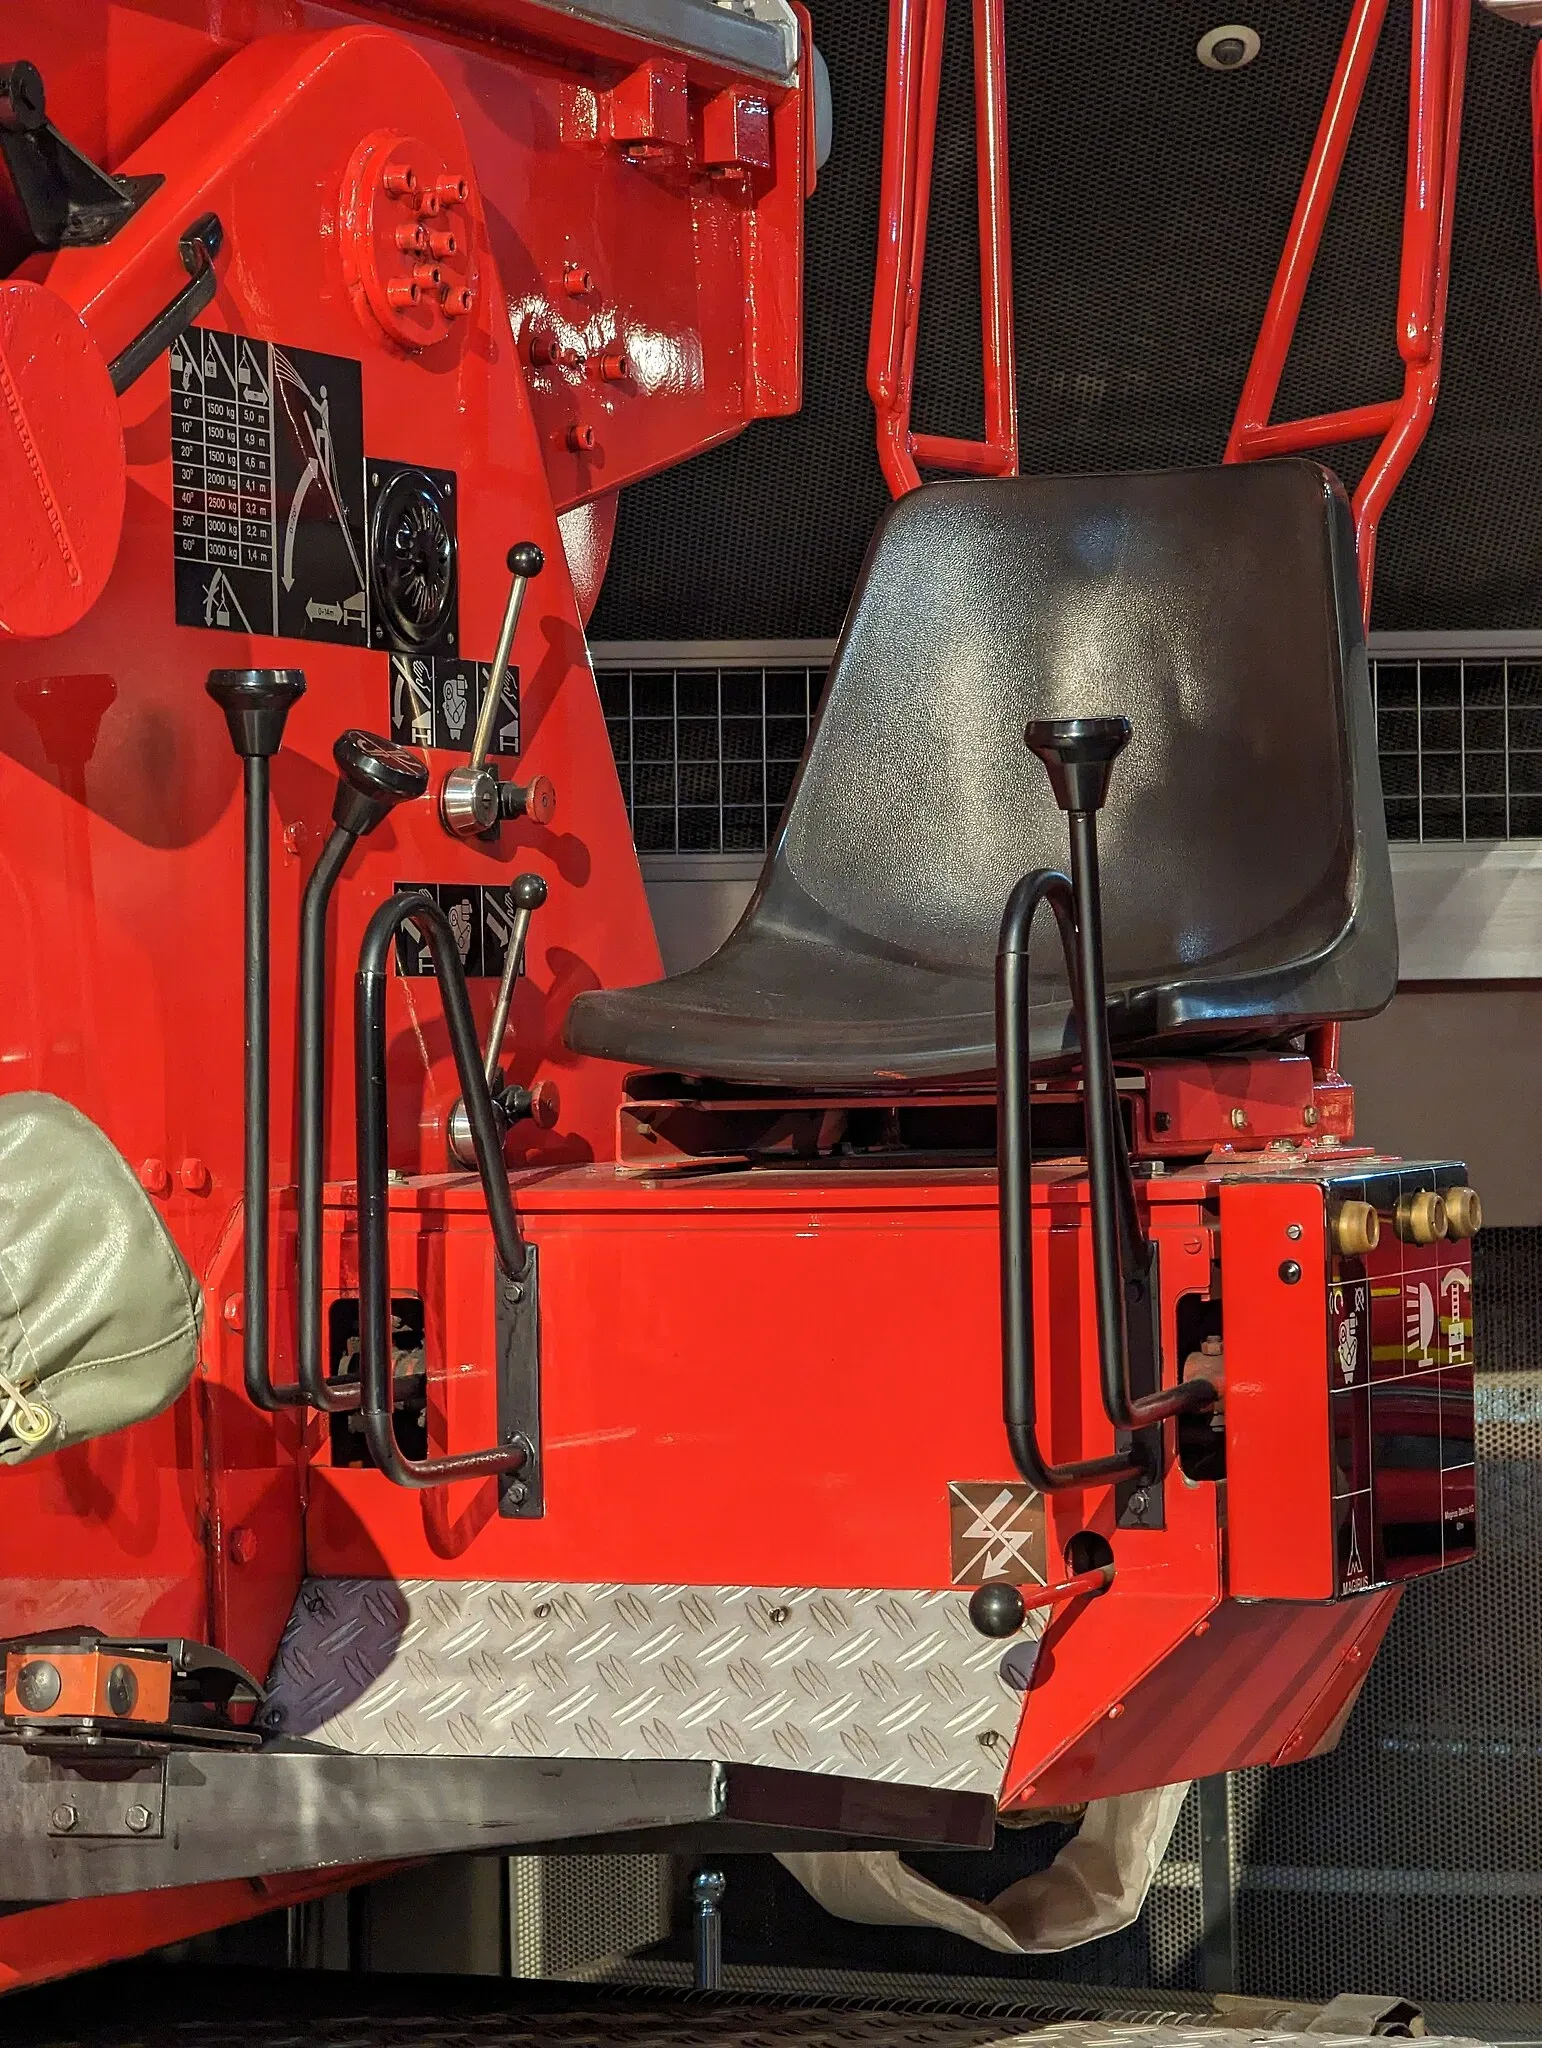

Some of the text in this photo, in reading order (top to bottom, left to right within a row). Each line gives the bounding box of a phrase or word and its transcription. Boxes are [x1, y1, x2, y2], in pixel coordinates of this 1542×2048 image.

[207, 402, 224, 415] 1500
[226, 406, 235, 420] kg
[244, 410, 254, 422] 5,0
[258, 415, 264, 424] m
[208, 426, 224, 439] 1500
[226, 429, 235, 443] kg
[244, 433, 255, 446] 4,9
[259, 438, 265, 447] m
[208, 450, 224, 463] 1500
[228, 453, 236, 467] kg
[245, 457, 256, 470] 4,6
[259, 461, 266, 470] m
[208, 472, 225, 486] 2000
[228, 476, 236, 489] kg
[246, 480, 255, 492] 4,1
[259, 484, 266, 492] m
[208, 496, 226, 510] 2500
[228, 500, 237, 513] kg
[246, 502, 257, 515] 3,2
[260, 507, 267, 516] m
[208, 520, 226, 533] 3000
[229, 523, 237, 536] kg
[246, 525, 257, 538] 2,2
[260, 528, 267, 538] m
[208, 544, 226, 556] 3000
[229, 546, 238, 560] kg
[248, 549, 257, 562] 1,4
[261, 553, 267, 562] m
[1342, 1576, 1369, 1594] MAGIRUS
